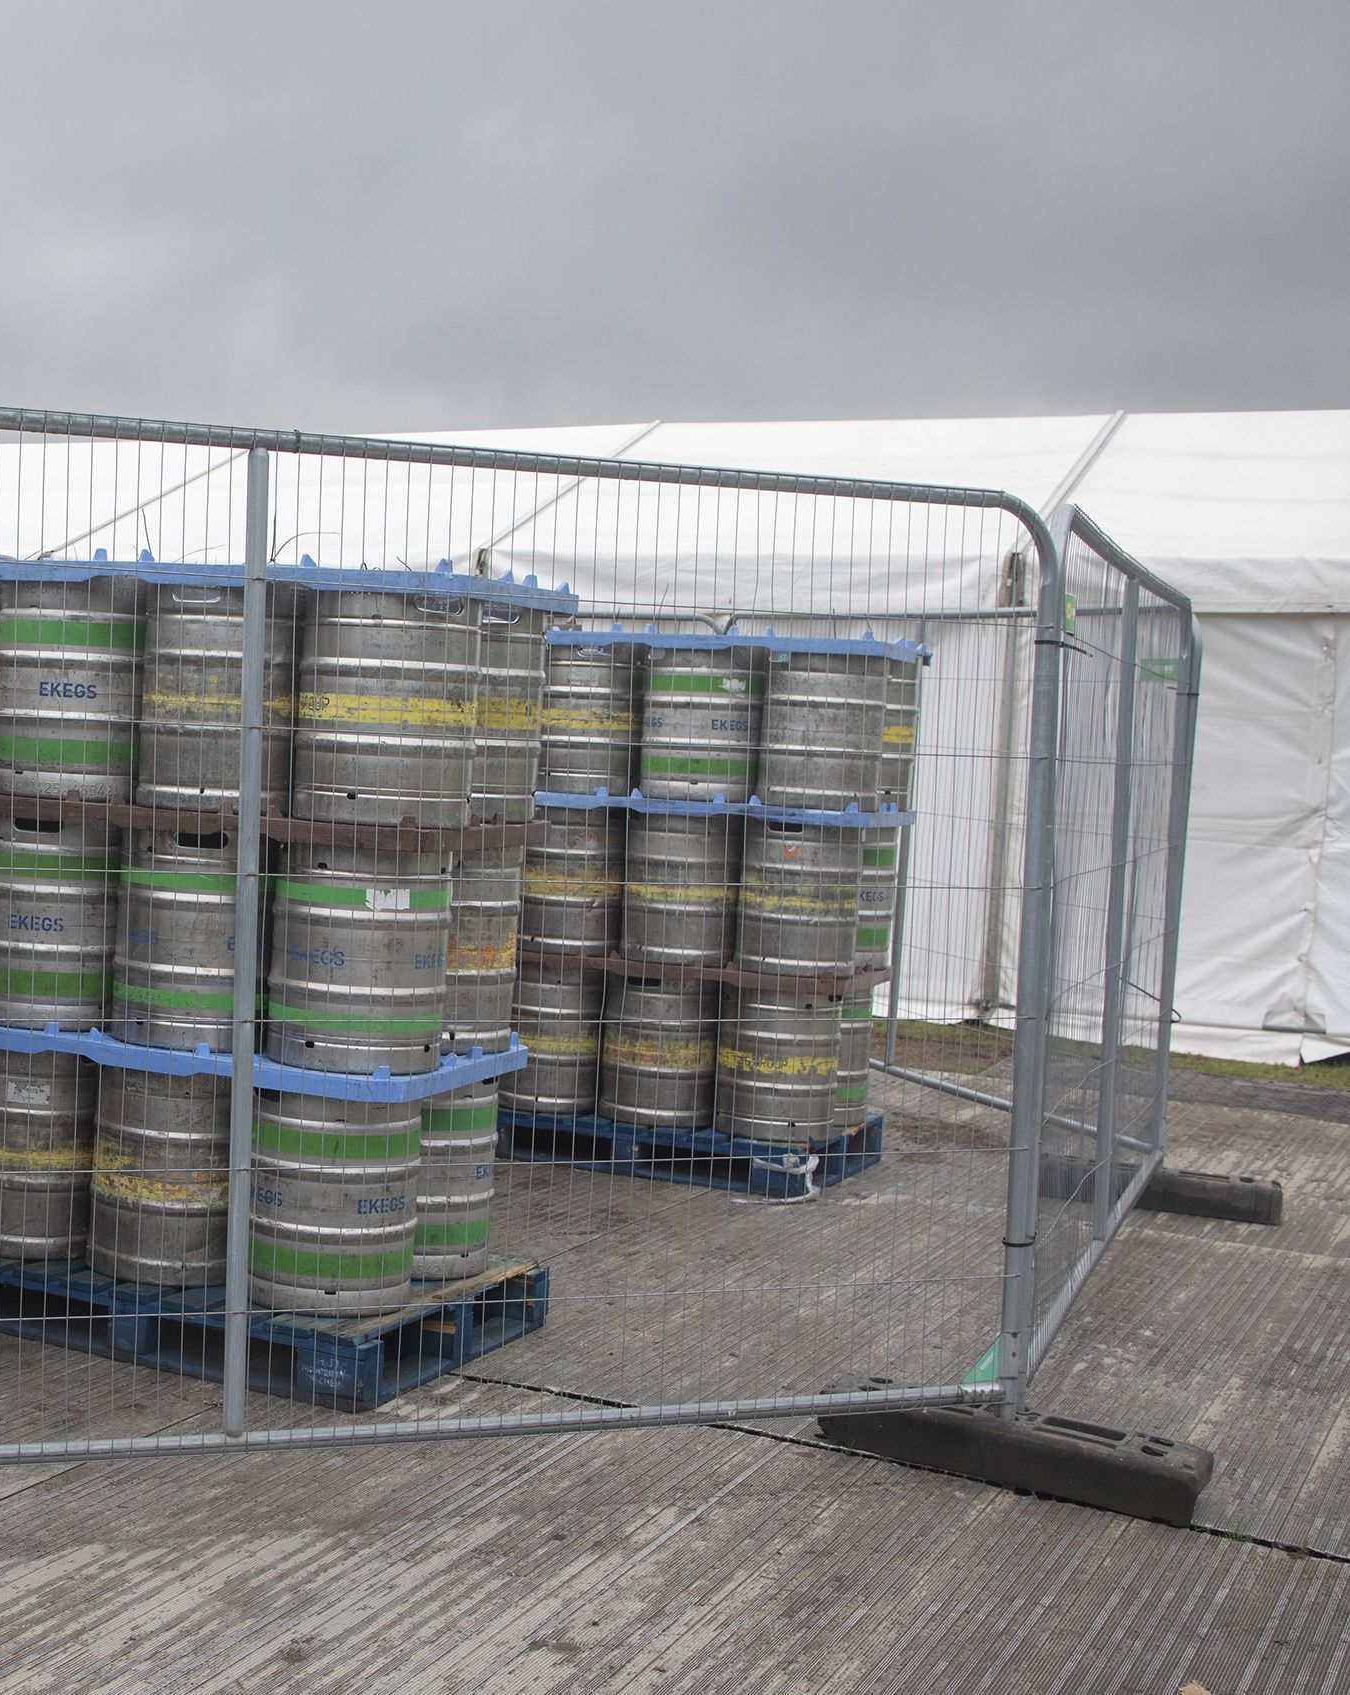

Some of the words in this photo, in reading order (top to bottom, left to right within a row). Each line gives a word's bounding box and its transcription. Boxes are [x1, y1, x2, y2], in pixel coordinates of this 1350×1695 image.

[39, 681, 97, 699] EKEGS
[711, 719, 749, 732] EKEGS
[8, 914, 64, 932] EKEGS
[357, 1195, 405, 1215] EKEGS
